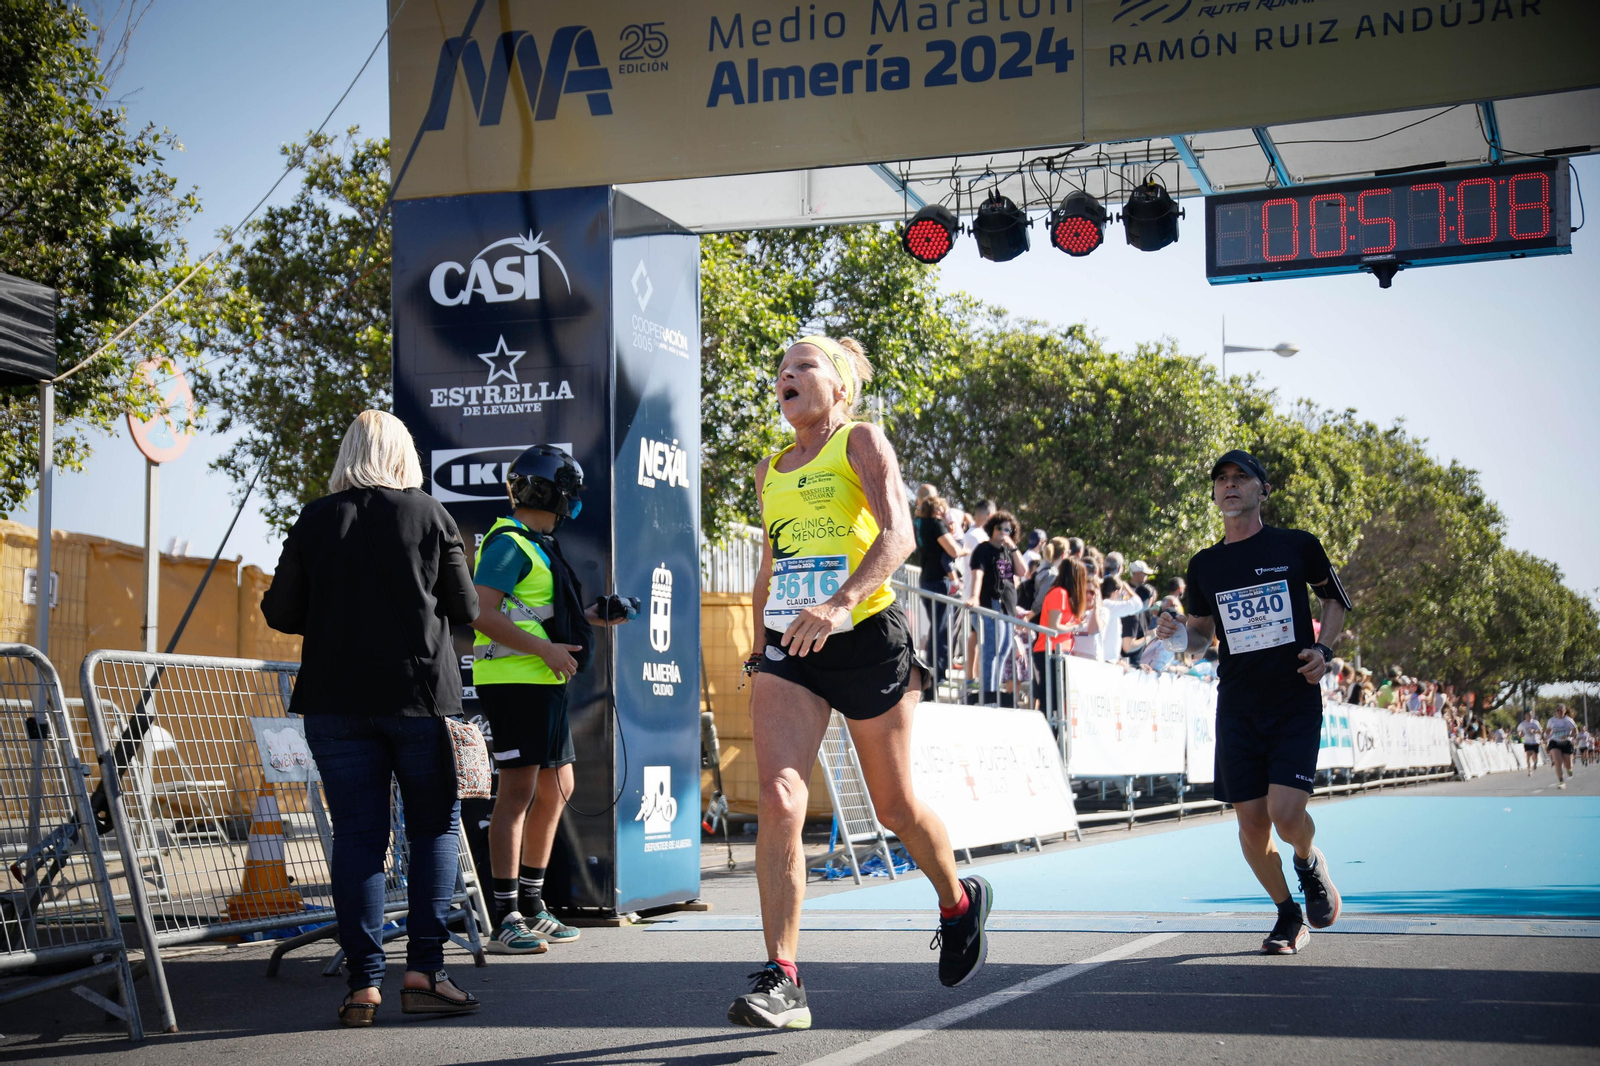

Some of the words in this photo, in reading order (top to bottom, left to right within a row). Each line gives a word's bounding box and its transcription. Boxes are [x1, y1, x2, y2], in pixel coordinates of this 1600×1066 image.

[1197, 1, 1251, 18] RUTA
[708, 4, 846, 52] Medio
[1109, 29, 1237, 67] RAMÓN
[1255, 18, 1339, 52] RUIZ
[1355, 0, 1542, 40] ANDÚJAR
[619, 22, 669, 61] 25
[618, 60, 669, 75] EDICIÓN
[706, 44, 910, 108] Almería
[924, 26, 1075, 88] 2024
[1261, 172, 1550, 262] 00:57:08
[429, 254, 541, 307] CASI
[631, 314, 689, 351] COOPERACIÓN
[632, 331, 653, 353] 2005
[430, 380, 575, 408] ESTRELLA
[462, 406, 480, 417] DE
[482, 402, 542, 416] LEVANTE
[451, 462, 511, 487] IK
[799, 486, 836, 498] BERKSHIRE
[802, 491, 834, 502] HATHAWAY
[791, 525, 857, 543] MENORCA
[792, 516, 836, 533] CLÍNICA
[776, 570, 840, 601] 5616
[786, 598, 817, 606] CLAUDIA
[1227, 594, 1284, 621] 5840
[1247, 615, 1267, 624] JORGE
[642, 660, 682, 684] ALMERÍA
[652, 683, 674, 696] CIUDAD
[1295, 773, 1314, 784] KELM
[644, 841, 669, 852] DEPORTES
